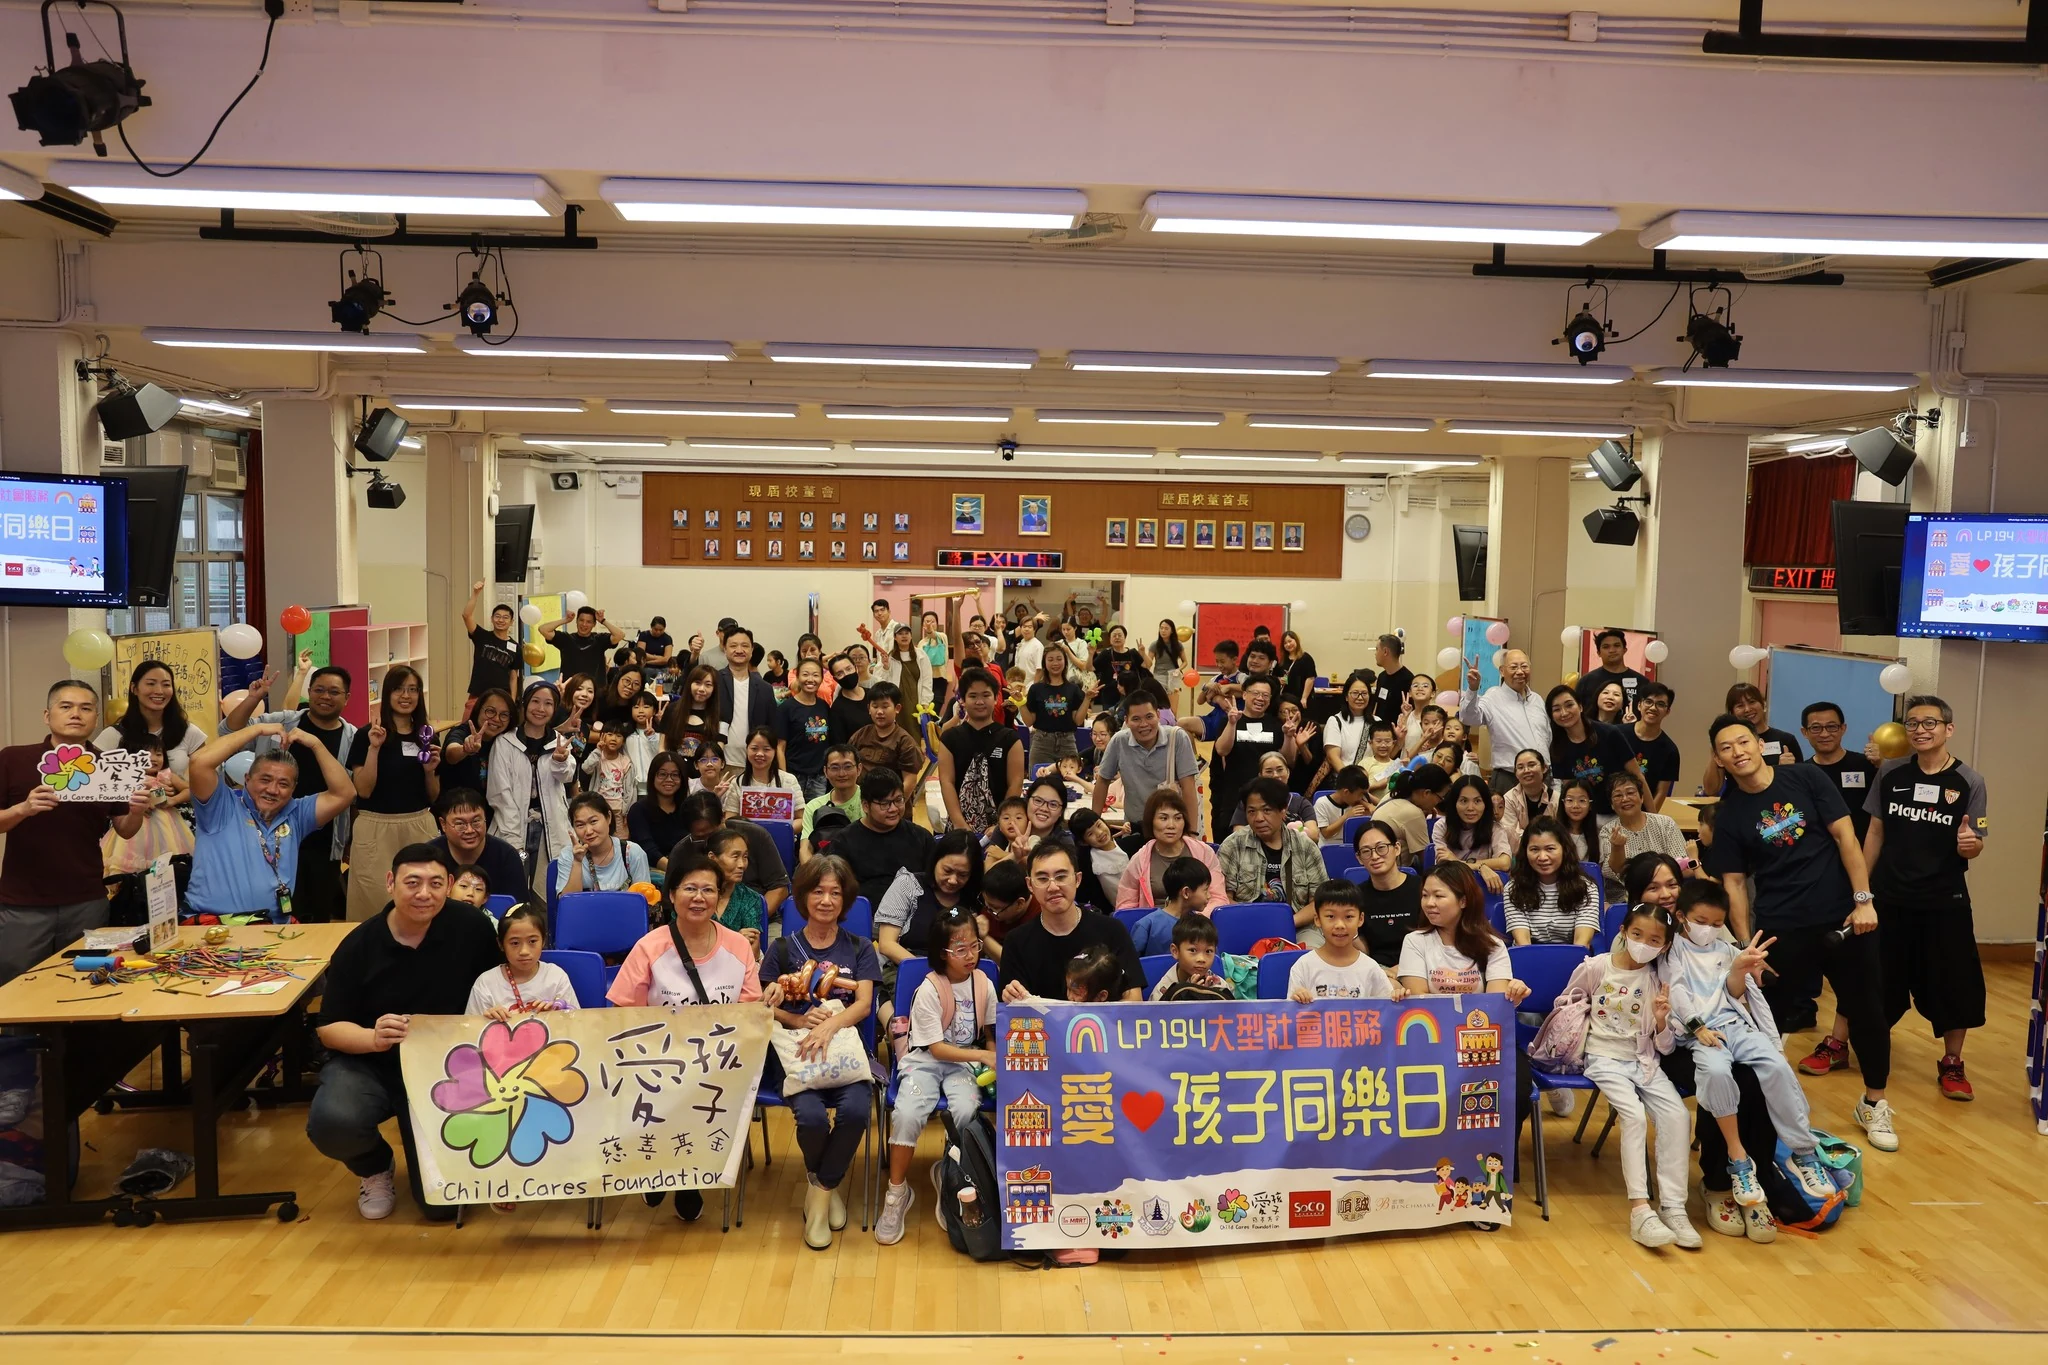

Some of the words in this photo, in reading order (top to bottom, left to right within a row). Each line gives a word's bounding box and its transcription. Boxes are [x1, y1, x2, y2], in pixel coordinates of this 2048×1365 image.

[0, 513, 73, 541] 同樂日
[1977, 531, 1992, 541] LP
[973, 552, 1028, 567] EXIT
[1774, 568, 1816, 589] EXIT
[1822, 570, 1835, 589] 出
[71, 793, 94, 801] Cares
[98, 793, 129, 801] Foundat
[1888, 802, 1953, 826] Playtika
[1116, 1019, 1152, 1049] LP
[1159, 1018, 1208, 1049] 194
[1061, 1071, 1115, 1145] 愛
[1170, 1064, 1448, 1145] 孩子同樂日
[599, 1128, 730, 1164] 慈善基金
[443, 1180, 510, 1202] Child
[523, 1177, 588, 1197] Cares
